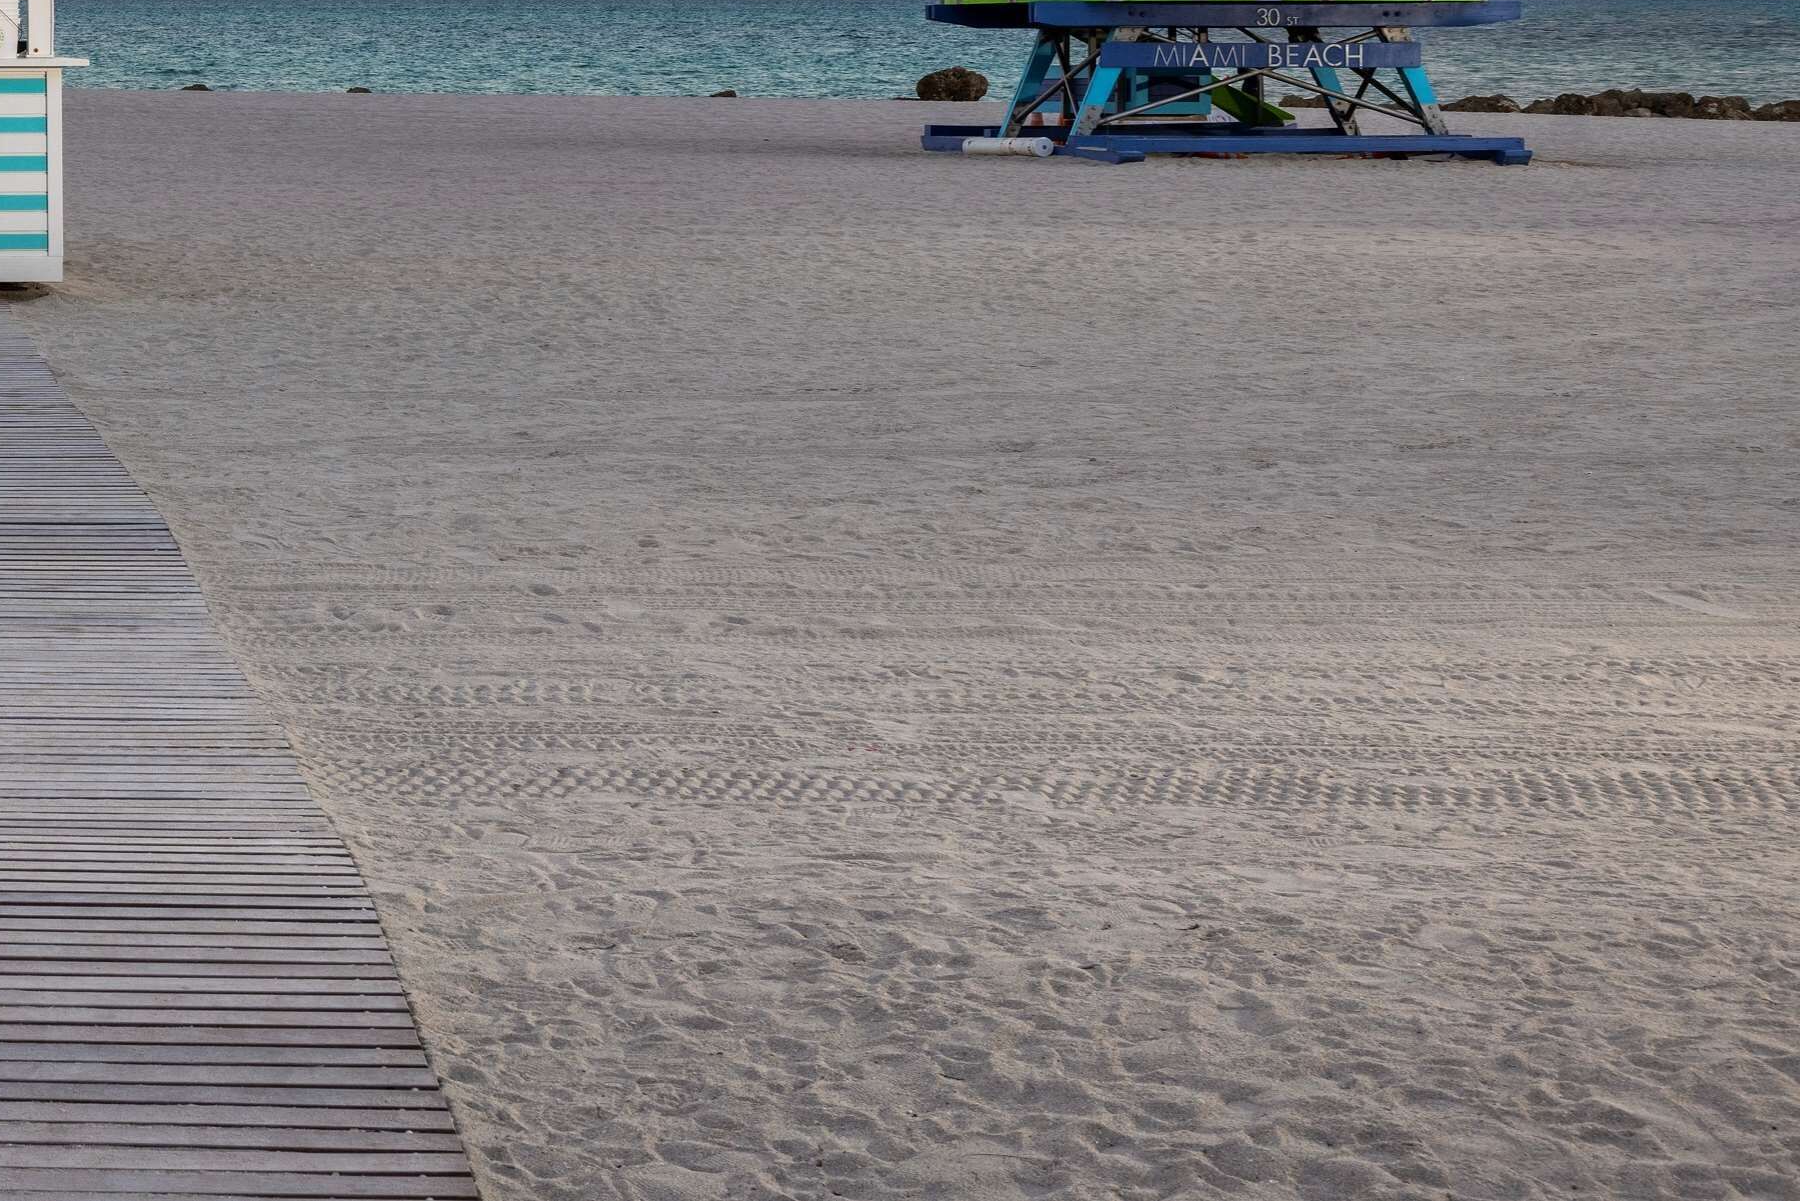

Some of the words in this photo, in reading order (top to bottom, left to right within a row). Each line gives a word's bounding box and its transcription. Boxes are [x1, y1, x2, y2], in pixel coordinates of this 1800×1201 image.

[1256, 8, 1281, 26] 30
[1153, 44, 1245, 67] MIAMI
[1267, 44, 1364, 68] BEACH
